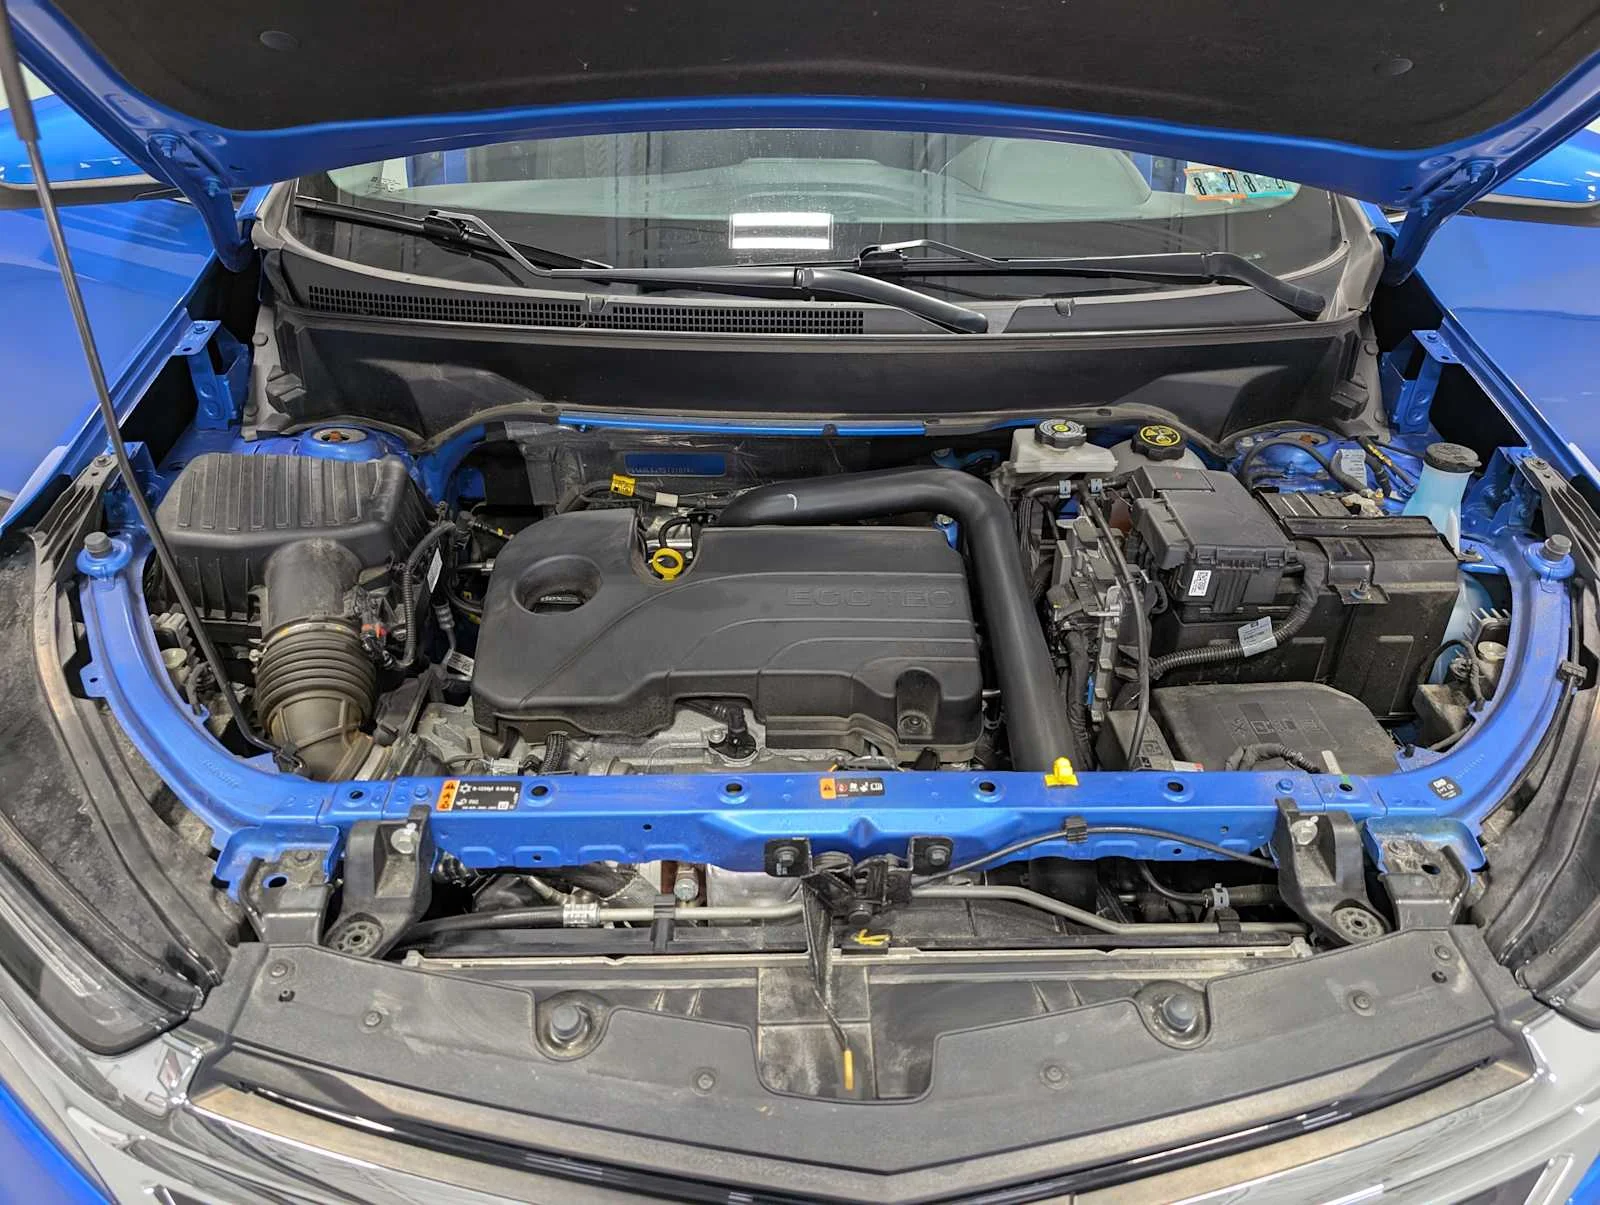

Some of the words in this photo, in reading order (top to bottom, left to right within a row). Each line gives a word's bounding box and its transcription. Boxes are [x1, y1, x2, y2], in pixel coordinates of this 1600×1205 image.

[1194, 177, 1207, 195] 8
[1222, 171, 1240, 193] 27
[1243, 174, 1257, 193] 8
